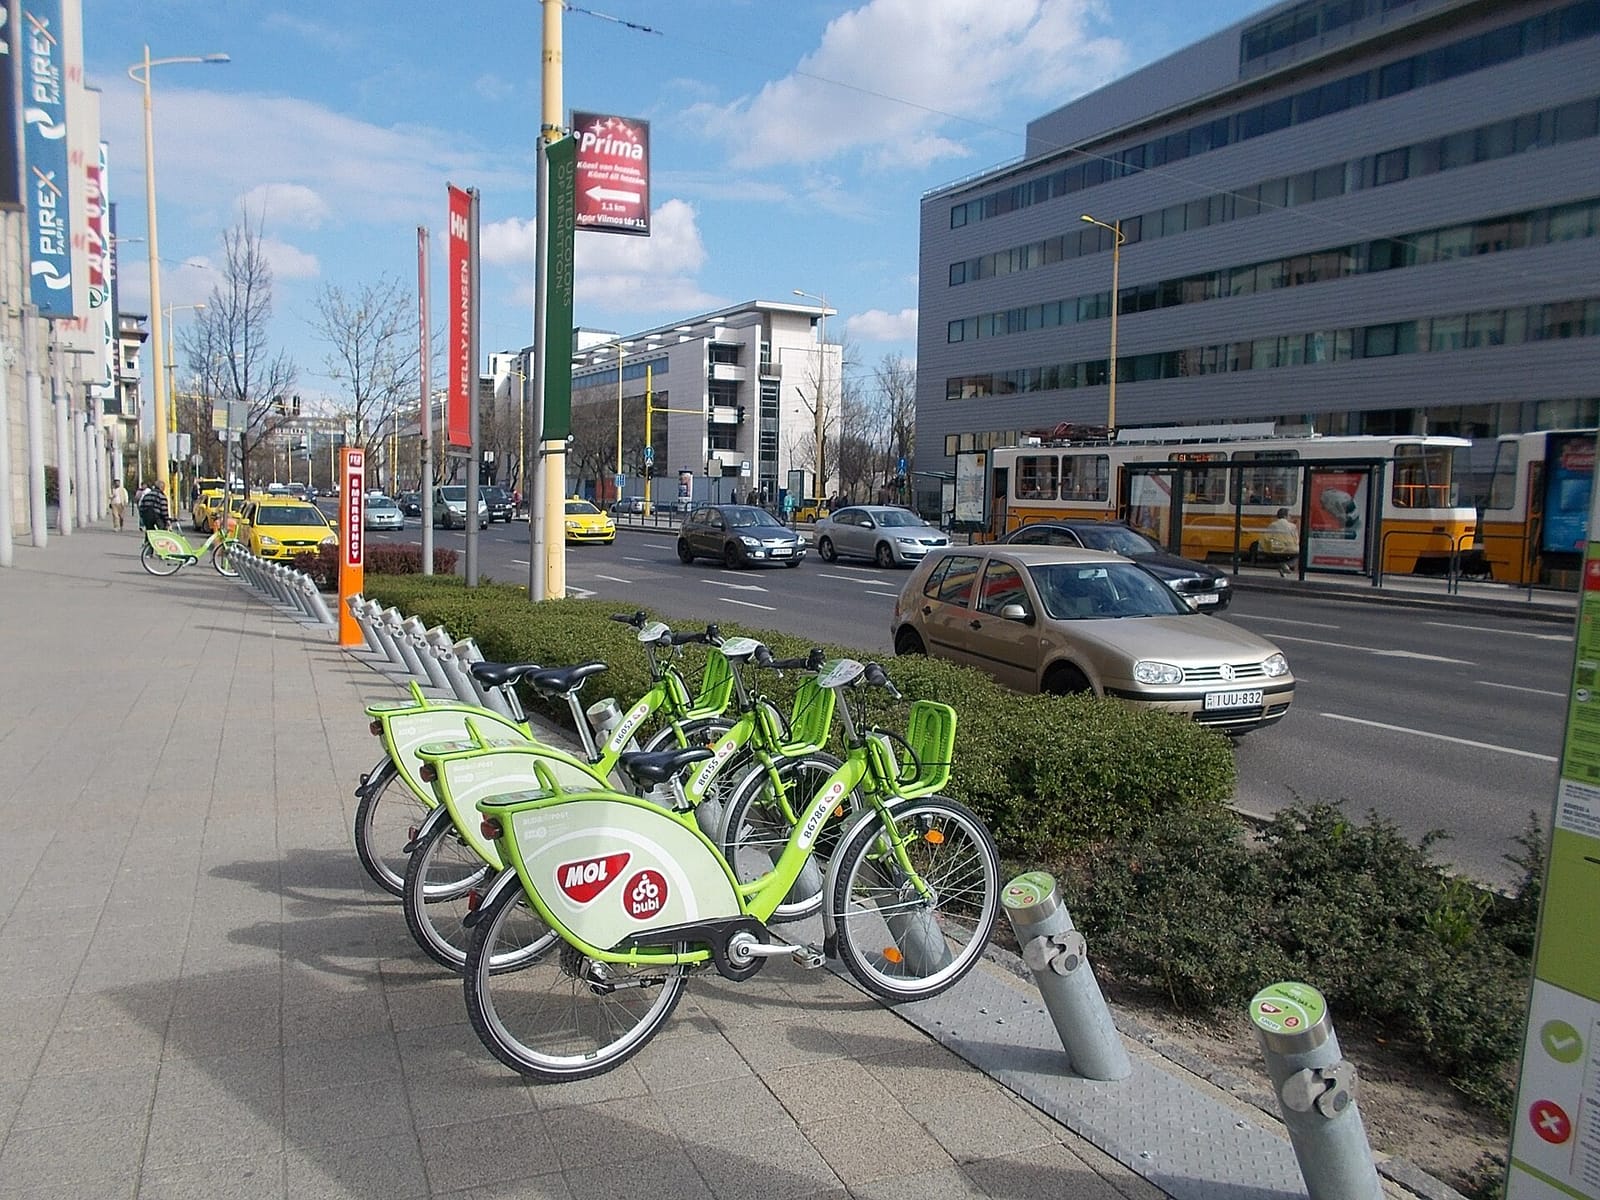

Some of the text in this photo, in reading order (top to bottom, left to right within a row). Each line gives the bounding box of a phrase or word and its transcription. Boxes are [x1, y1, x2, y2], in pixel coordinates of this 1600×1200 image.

[28, 11, 57, 104] PIREX
[557, 165, 565, 190] OF
[32, 165, 62, 255] PIREX
[576, 213, 596, 225] Apor
[597, 213, 623, 224] Vilmos
[563, 161, 573, 306] UNITED COLORS
[460, 259, 469, 396] HELLY HANSEN
[351, 478, 360, 559] EMERGENCY
[1216, 692, 1261, 706] IUU-832
[614, 719, 633, 745] 86052
[698, 759, 719, 786] 86155
[803, 805, 827, 839] 86786
[564, 860, 608, 888] MOL
[632, 896, 660, 915] bubi
